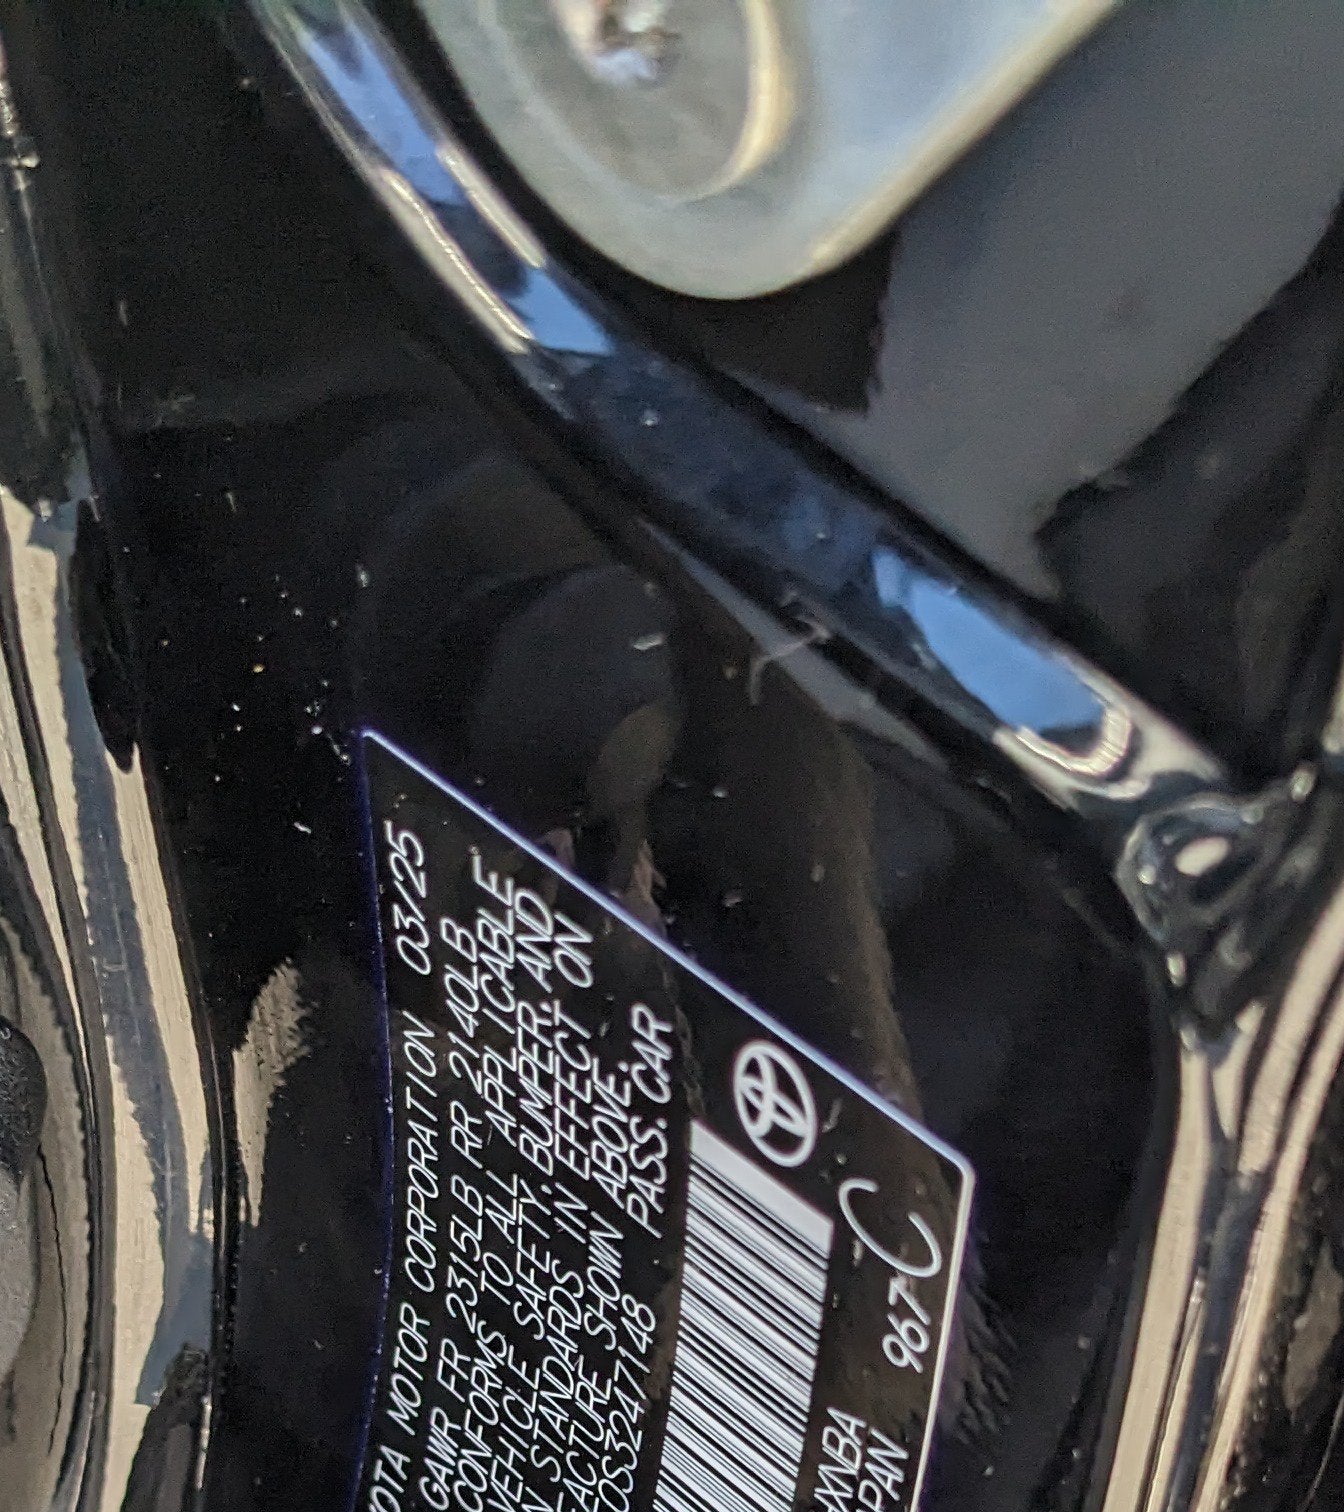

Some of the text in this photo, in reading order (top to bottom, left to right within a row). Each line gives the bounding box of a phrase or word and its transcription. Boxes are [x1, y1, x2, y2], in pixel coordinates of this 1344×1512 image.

[385, 819, 430, 976] 03/25
[517, 886, 555, 992] AND
[554, 911, 595, 989] ON
[440, 914, 481, 1095] 2140LB
[473, 854, 518, 1147] APPLICABLE
[630, 1000, 677, 1106] CAR
[403, 1014, 436, 1293] CORPORATION
[451, 1099, 484, 1168] RR
[554, 998, 592, 1180] EFFECT
[586, 1056, 630, 1209] ABOVE.
[447, 1174, 484, 1332] 2315LB
[485, 1169, 518, 1244] ALL
[554, 1182, 589, 1243] IN
[481, 1250, 512, 1305] TO
[584, 1211, 626, 1351] SHOWN
[388, 1301, 431, 1435] MOTOR
[434, 1336, 471, 1402] FR
[533, 1258, 586, 1483] STANDARDS
[418, 1405, 463, 1512] GAWR
